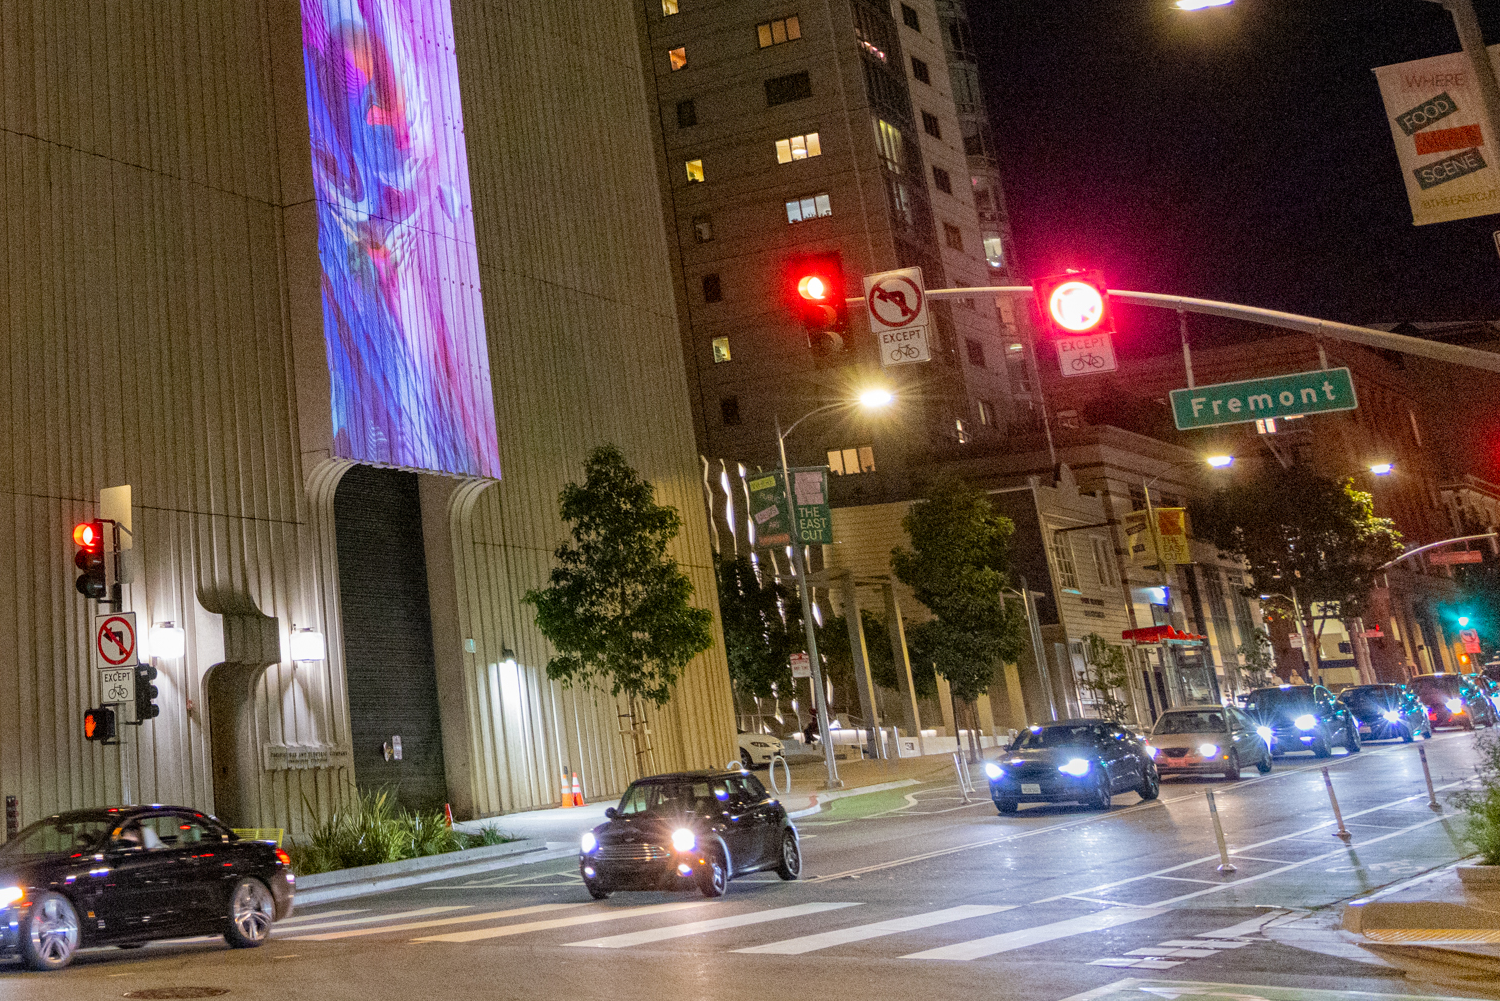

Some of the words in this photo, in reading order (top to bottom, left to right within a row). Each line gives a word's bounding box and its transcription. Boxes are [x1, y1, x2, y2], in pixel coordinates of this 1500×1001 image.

[1405, 73, 1465, 88] WHERE
[1402, 100, 1449, 130] FOOD
[1421, 153, 1478, 183] SCENE
[883, 330, 921, 344] EXCEPT
[1061, 338, 1104, 352] EXCEPT
[1191, 381, 1336, 418] Fremont
[798, 506, 820, 518] THE
[800, 518, 827, 529] EAST
[801, 529, 824, 541] CUT
[1163, 544, 1184, 553] EAST
[104, 672, 131, 682] EXCEPT
